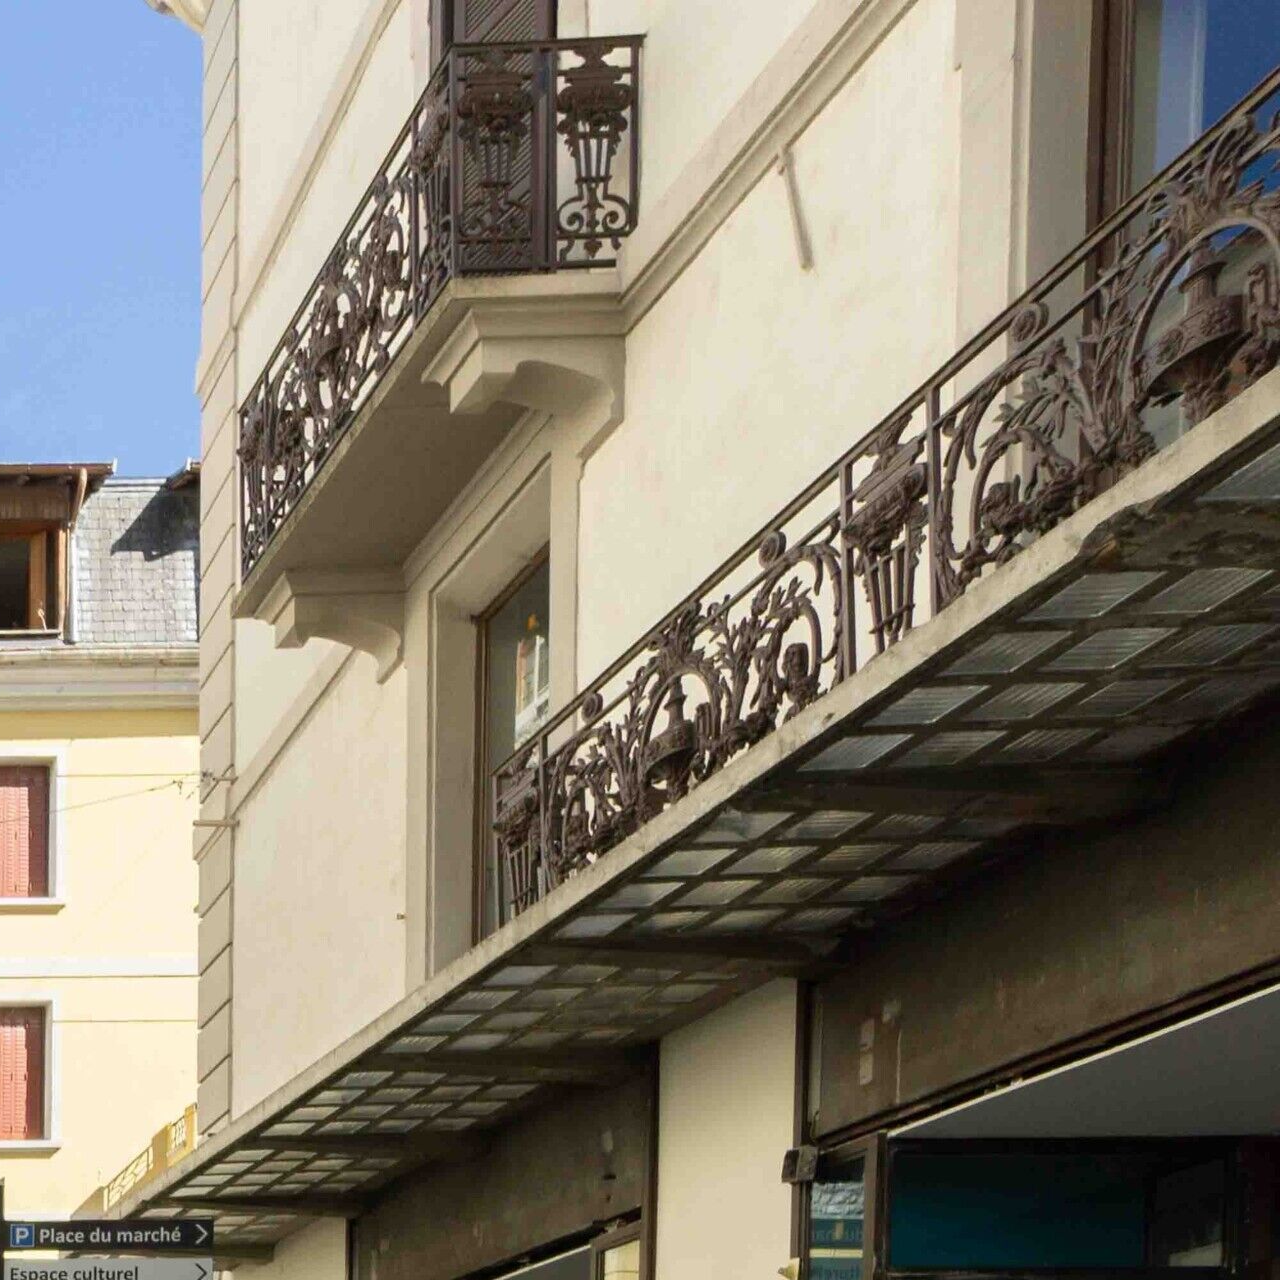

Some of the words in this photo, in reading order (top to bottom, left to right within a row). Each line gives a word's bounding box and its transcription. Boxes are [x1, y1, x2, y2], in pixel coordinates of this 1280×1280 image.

[40, 1228, 84, 1243] Place
[89, 1227, 111, 1243] du
[117, 1226, 181, 1243] marché
